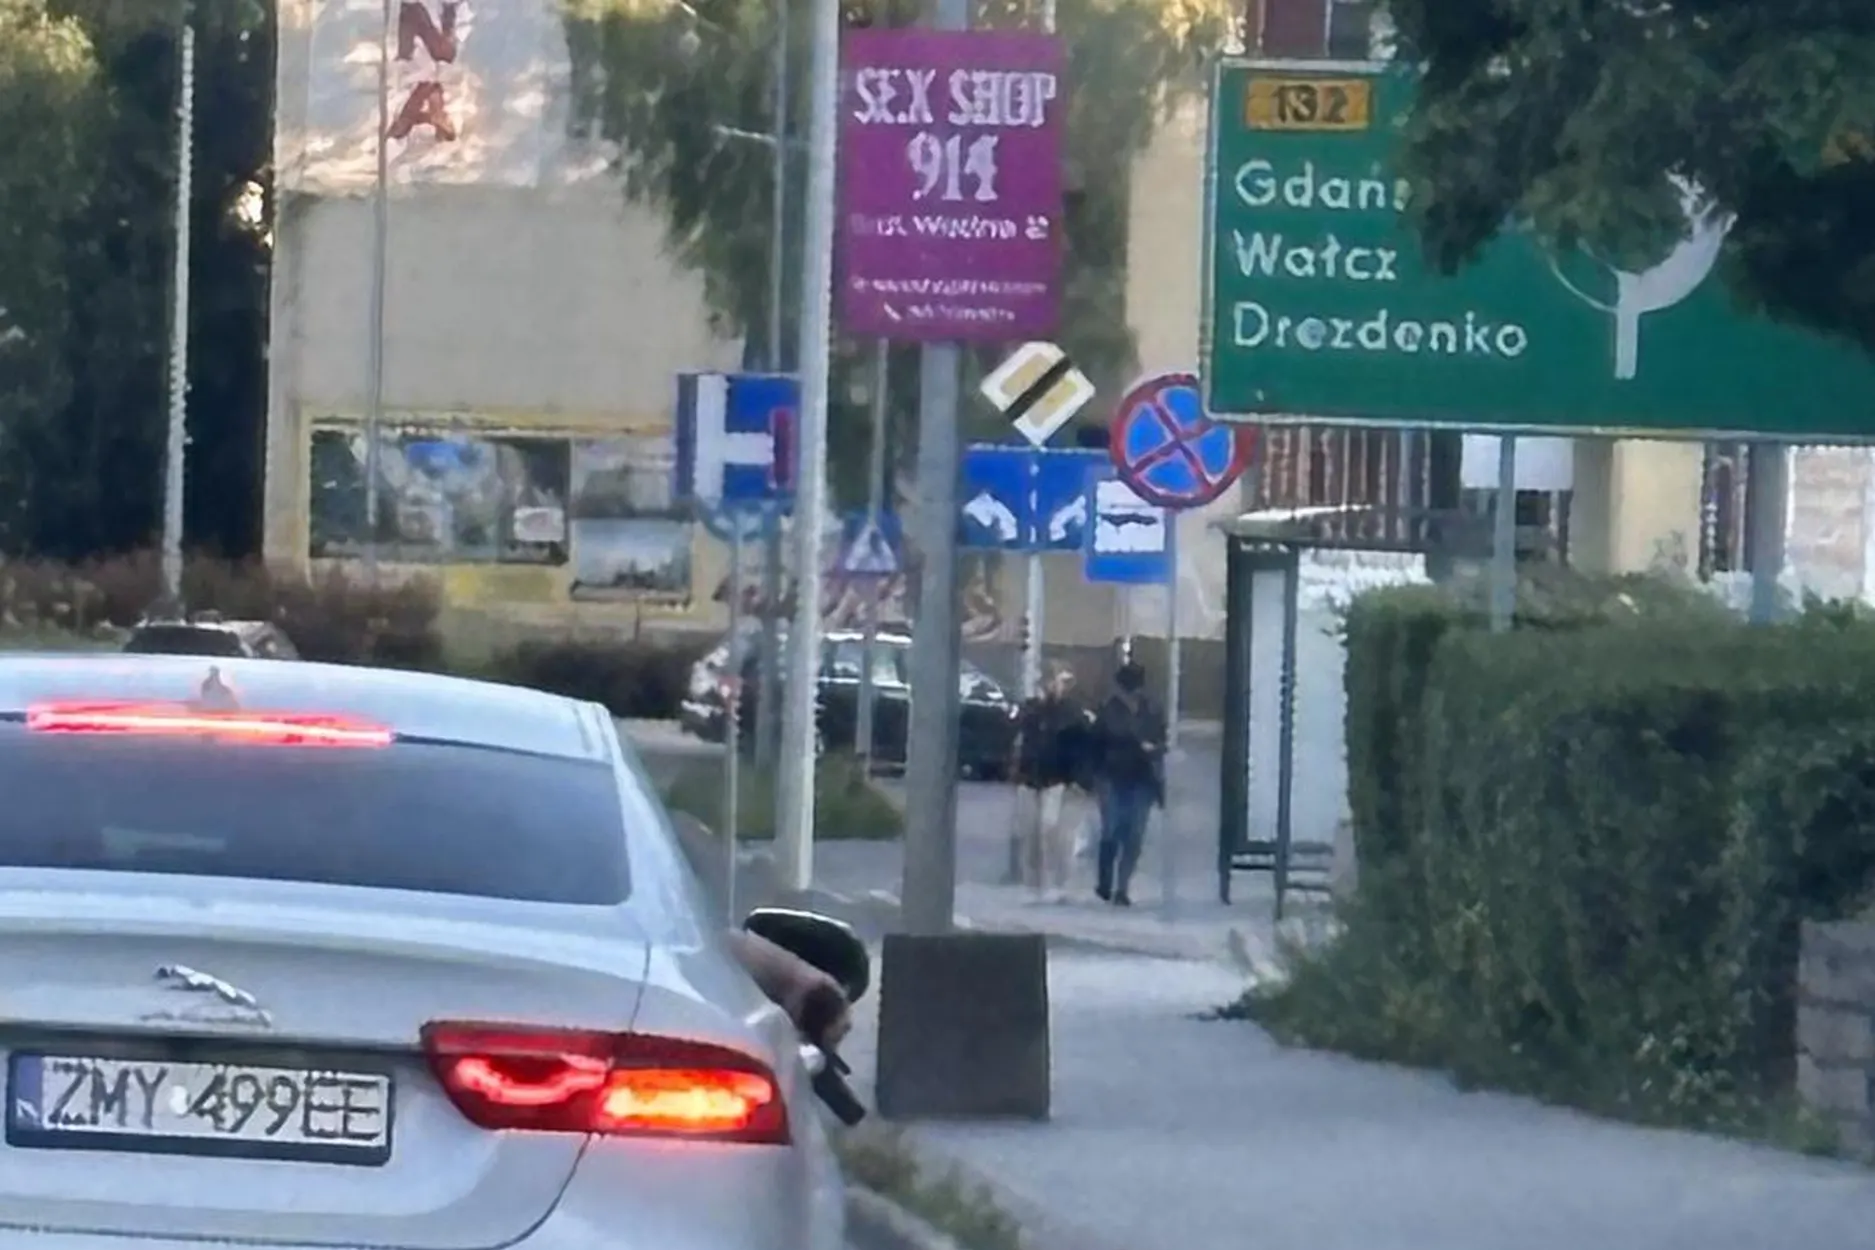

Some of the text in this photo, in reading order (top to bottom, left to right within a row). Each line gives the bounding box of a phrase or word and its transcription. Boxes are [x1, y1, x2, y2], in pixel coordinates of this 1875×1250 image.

[853, 67, 1056, 127] SEX SHOP
[1271, 84, 1349, 123] 132
[907, 131, 998, 200] 914
[1233, 229, 1397, 280] Wałcz
[1234, 301, 1527, 356] Drezdenko
[46, 1060, 381, 1140] ZMY 499EE
